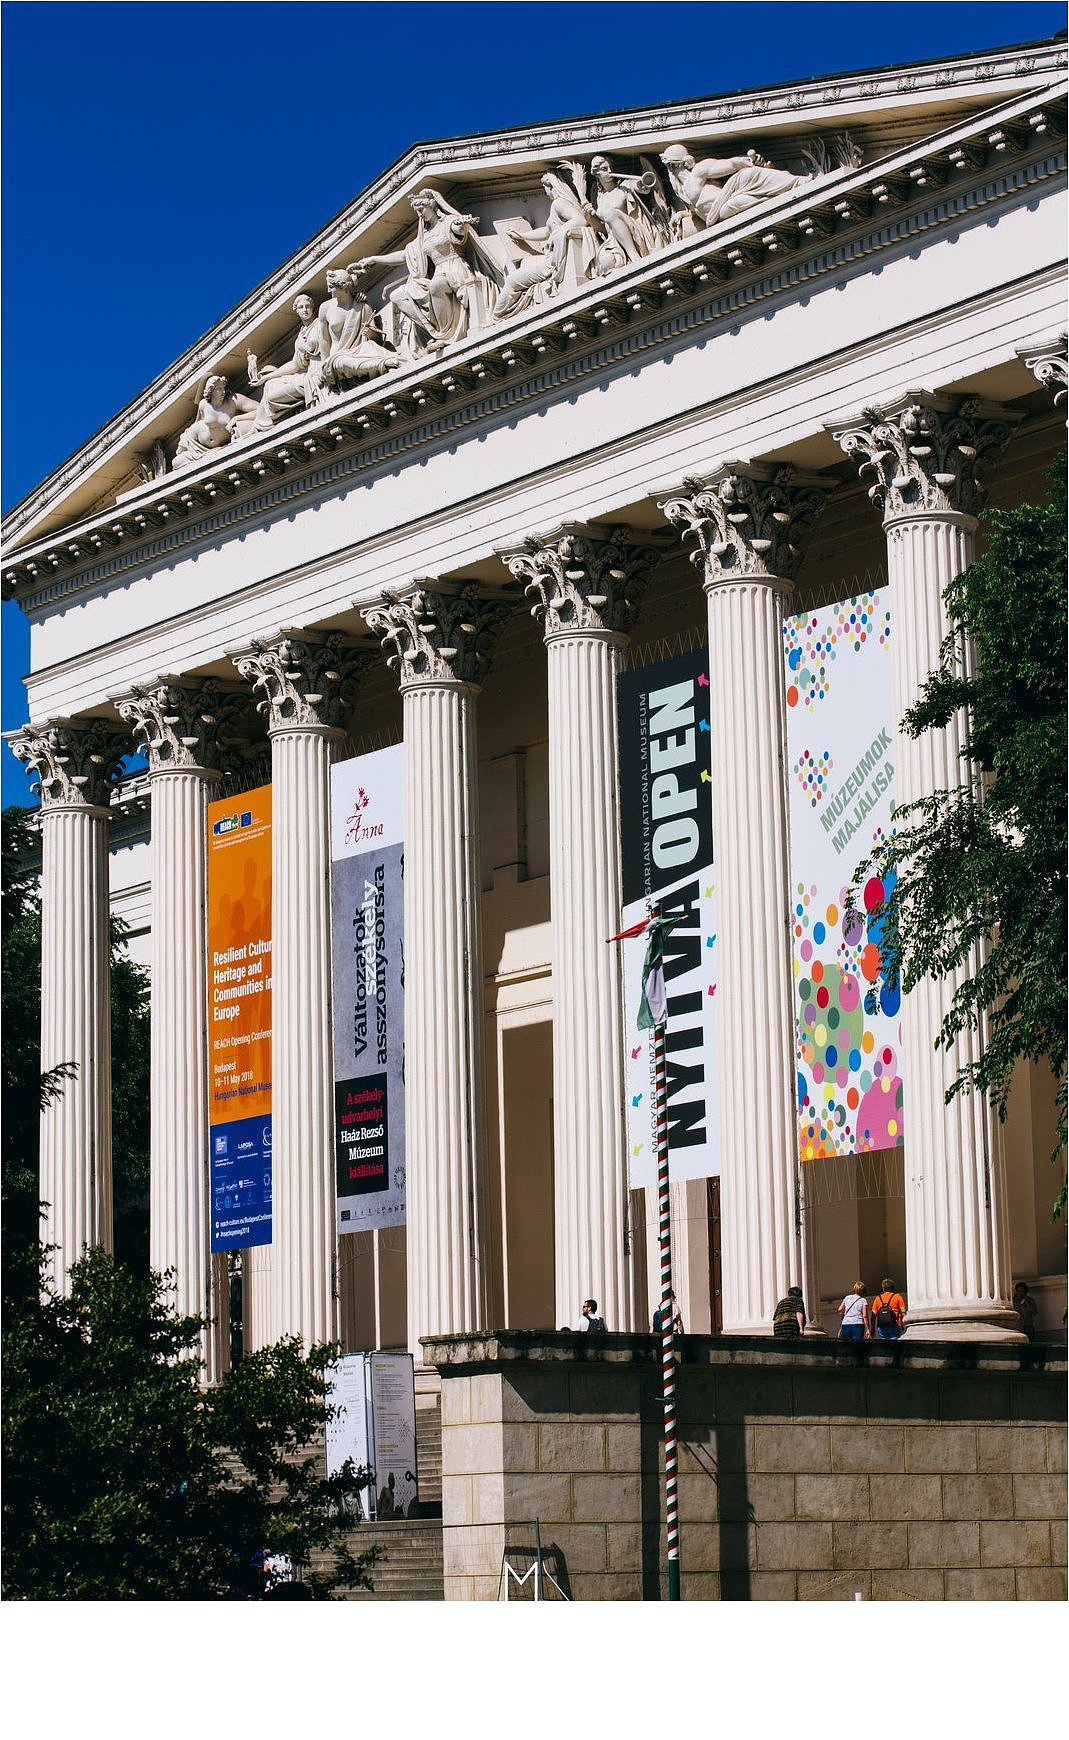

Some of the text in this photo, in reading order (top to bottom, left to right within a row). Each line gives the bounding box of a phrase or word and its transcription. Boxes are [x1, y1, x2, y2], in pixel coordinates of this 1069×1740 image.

[649, 679, 699, 869] OPEN
[820, 727, 892, 832] MÚZEUMOK
[641, 764, 649, 836] NATIONAL
[832, 761, 894, 855] MAJÁLISA
[345, 814, 383, 844] Anna
[643, 842, 653, 919] UNGARIAN
[362, 880, 378, 996] székely
[214, 945, 247, 966] Resilient
[374, 864, 388, 1065] asszonysorsra
[214, 958, 262, 984] Heritage and
[353, 907, 367, 1058] Változatok
[214, 979, 263, 1002] Communities
[214, 1004, 240, 1022] Europe
[214, 1039, 231, 1049] REACH
[231, 1035, 250, 1047] Opening
[214, 1061, 236, 1074] Budapest
[230, 1073, 240, 1085] May
[241, 1070, 254, 1082] 2018
[214, 1090, 238, 1101] Hungarian
[239, 1085, 257, 1096] National
[346, 1091, 353, 1105] A
[341, 1106, 384, 1125] udvarhelyi
[650, 1092, 658, 1154] MAGYAR
[341, 1124, 384, 1143] Haáz Rezső
[349, 1145, 384, 1161] Múzeum
